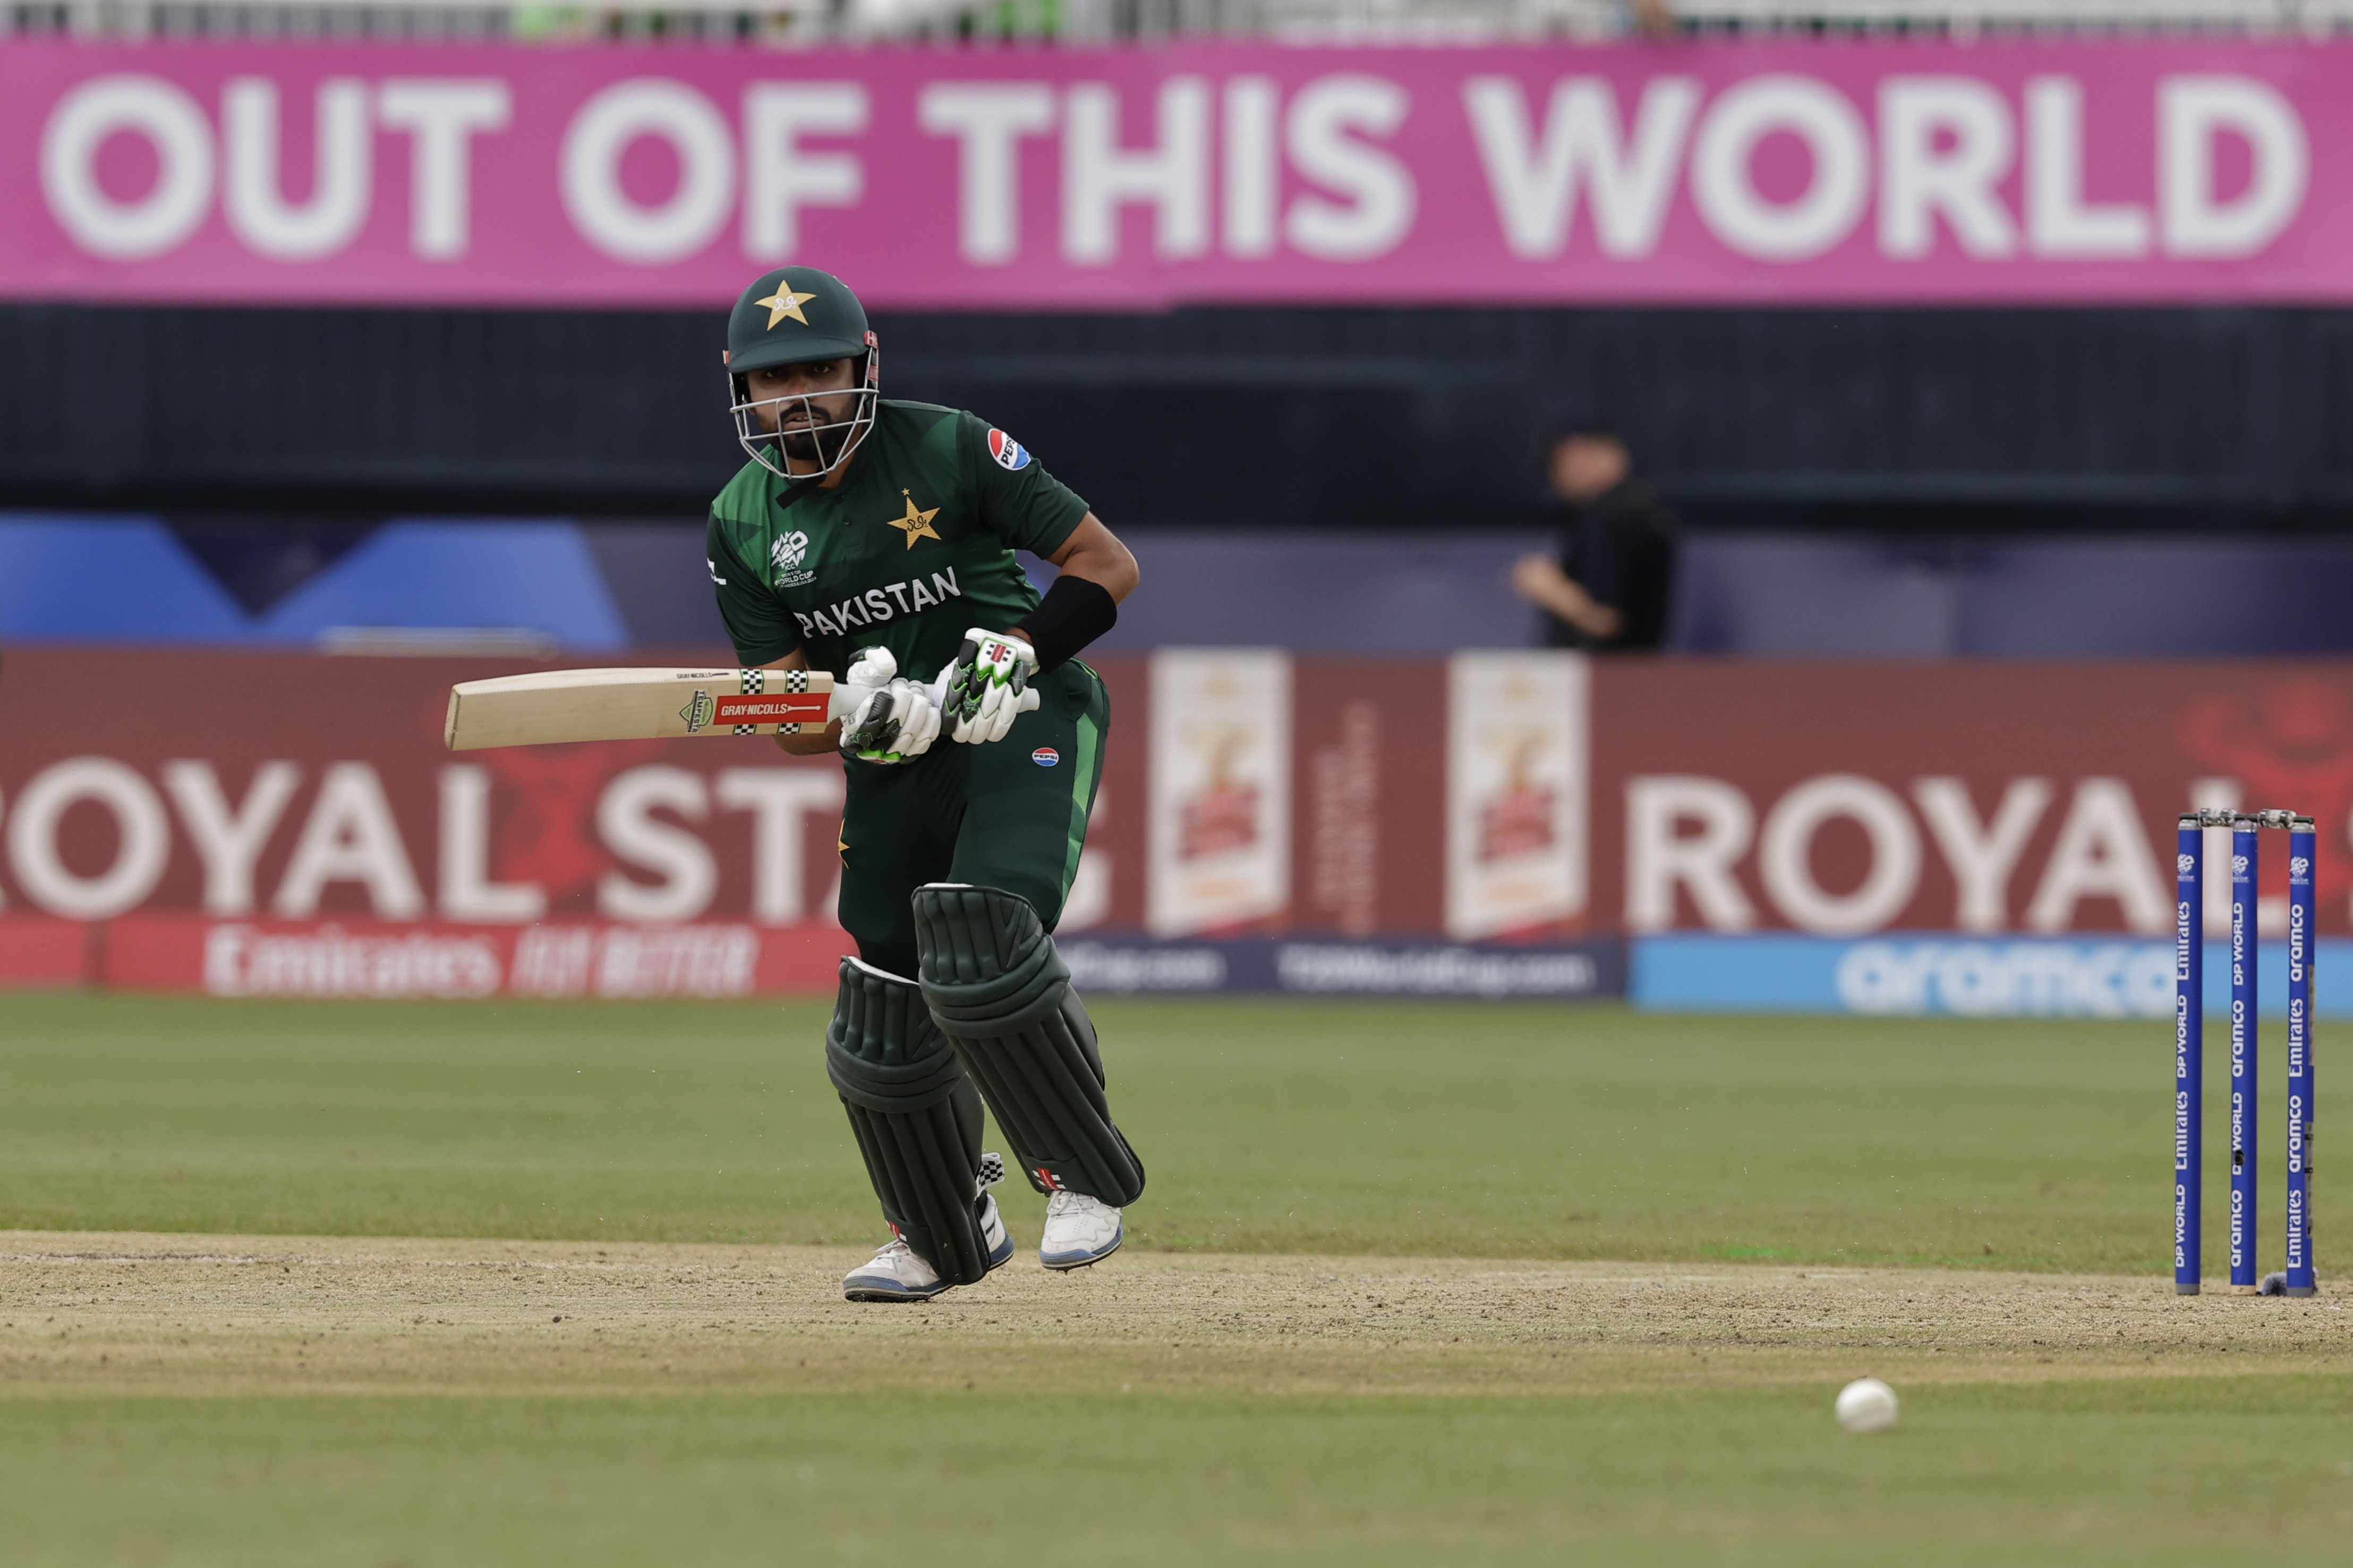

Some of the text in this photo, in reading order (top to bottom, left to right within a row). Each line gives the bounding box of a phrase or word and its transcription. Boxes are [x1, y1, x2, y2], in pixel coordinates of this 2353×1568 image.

[38, 72, 2312, 262] OUT OF THIS WORLD
[774, 570, 814, 586] WORLD CUP
[793, 566, 961, 638] PAKISTAN
[692, 690, 705, 732] TEMPESTA
[721, 704, 788, 716] GRAY-NICOLLS
[0, 757, 547, 921] OYAL
[2177, 901, 2190, 981] Emirates
[2233, 902, 2245, 986] DP WORLD
[2291, 904, 2304, 982] aramco
[2177, 994, 2187, 1078] DP WORLD
[2232, 999, 2245, 1077] aramco
[2288, 998, 2304, 1078] Emirates
[2175, 1091, 2188, 1170] Emirates
[2232, 1092, 2243, 1152] WORLD
[2289, 1094, 2302, 1173] aramco
[2175, 1184, 2186, 1267] DP WORLD
[2230, 1189, 2243, 1267] aramco
[2287, 1189, 2302, 1269] Emirates
